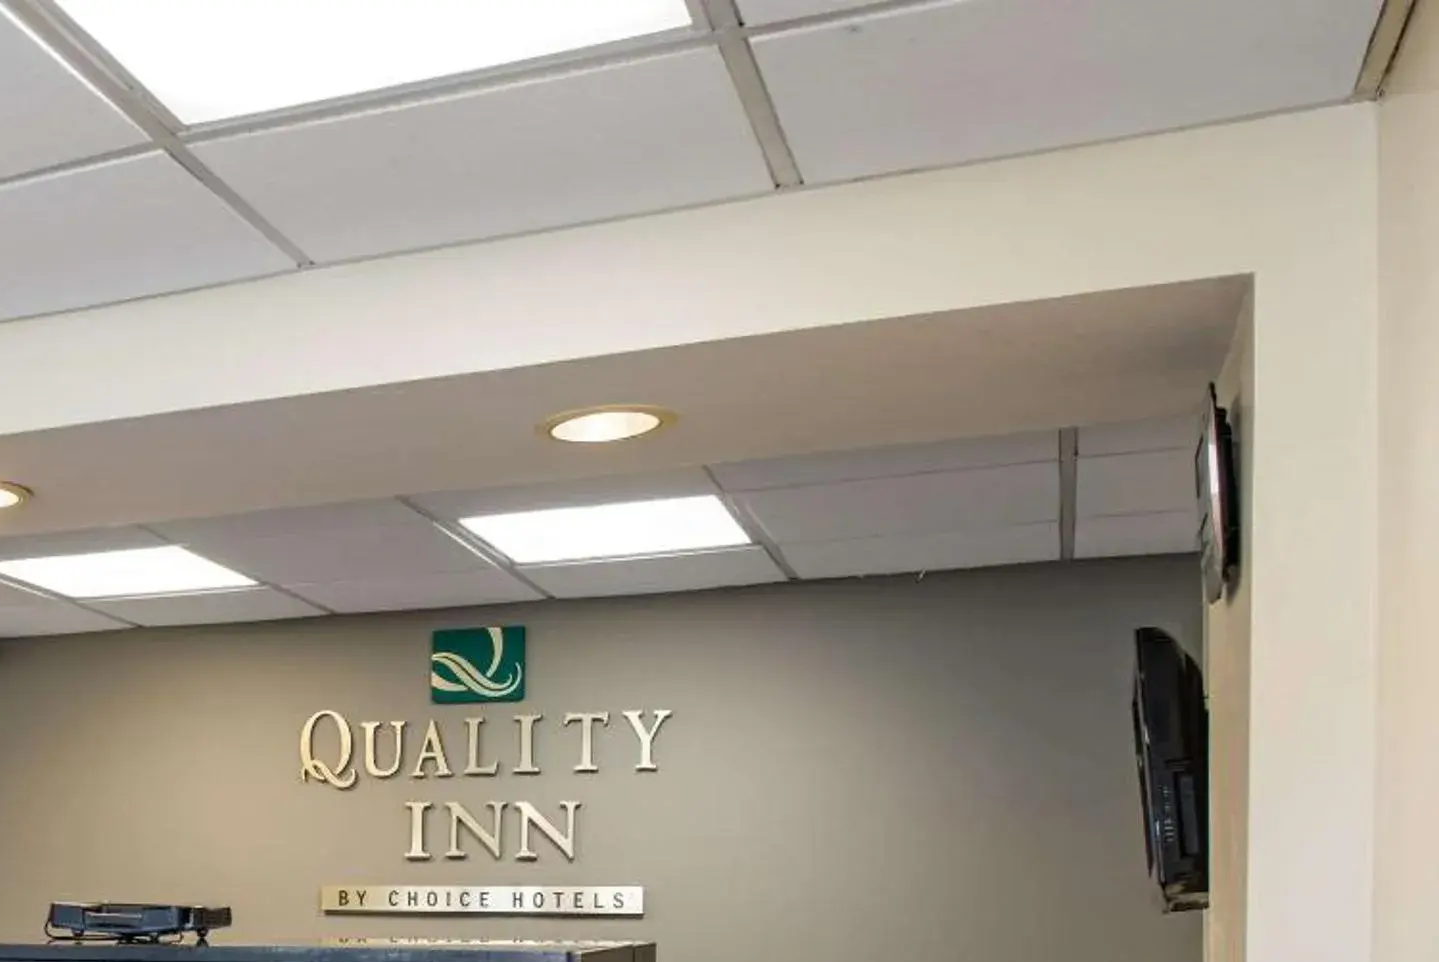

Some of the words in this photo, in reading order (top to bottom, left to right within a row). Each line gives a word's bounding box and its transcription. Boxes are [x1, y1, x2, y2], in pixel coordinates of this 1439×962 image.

[300, 709, 672, 789] QUALITY
[404, 800, 582, 862] INN
[338, 889, 367, 907] BY
[388, 890, 490, 909] CHOICE
[512, 891, 624, 910] HOTELS
